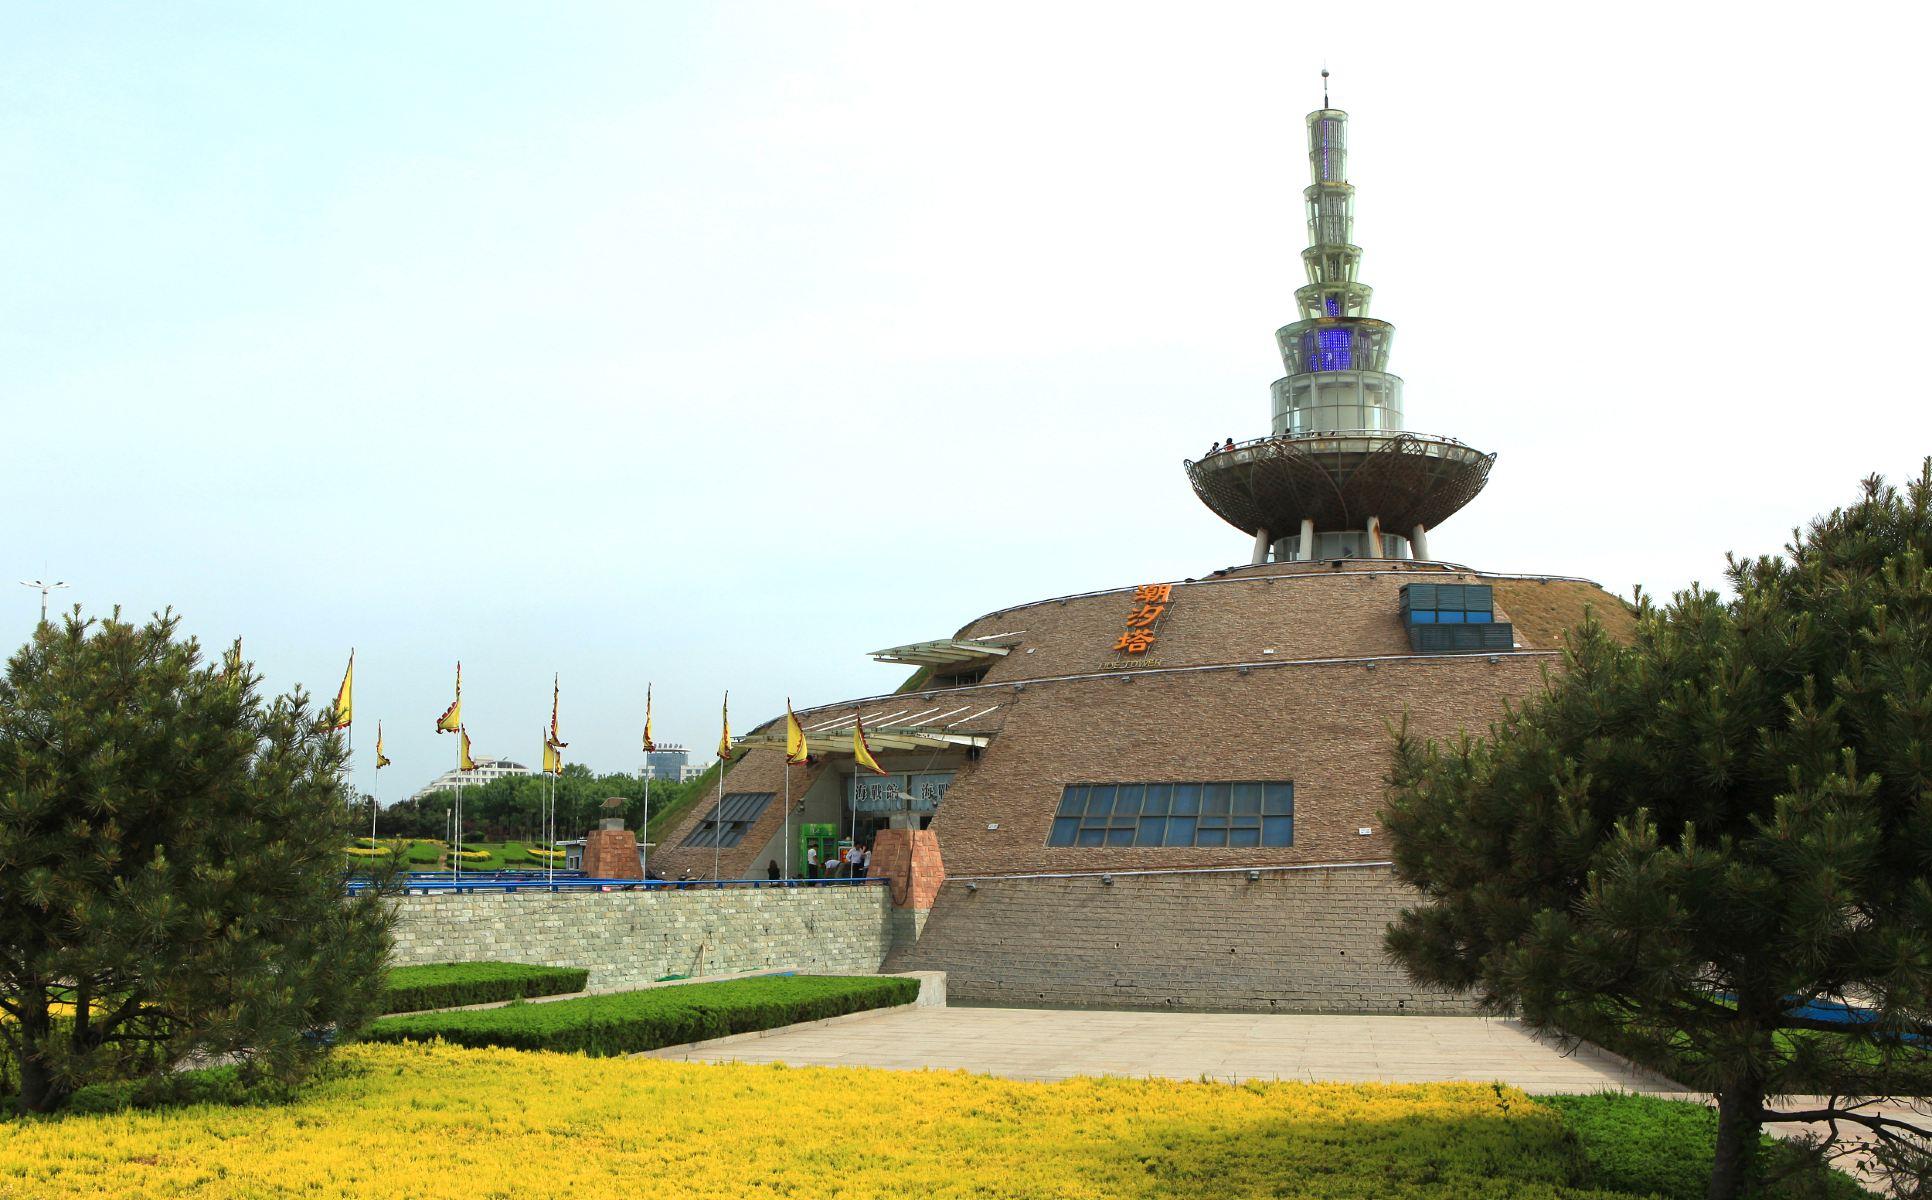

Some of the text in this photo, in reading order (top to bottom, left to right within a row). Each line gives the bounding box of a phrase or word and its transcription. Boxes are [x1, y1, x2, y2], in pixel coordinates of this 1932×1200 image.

[1113, 584, 1172, 653] 潮汐塔
[1123, 659, 1162, 668] TOWER
